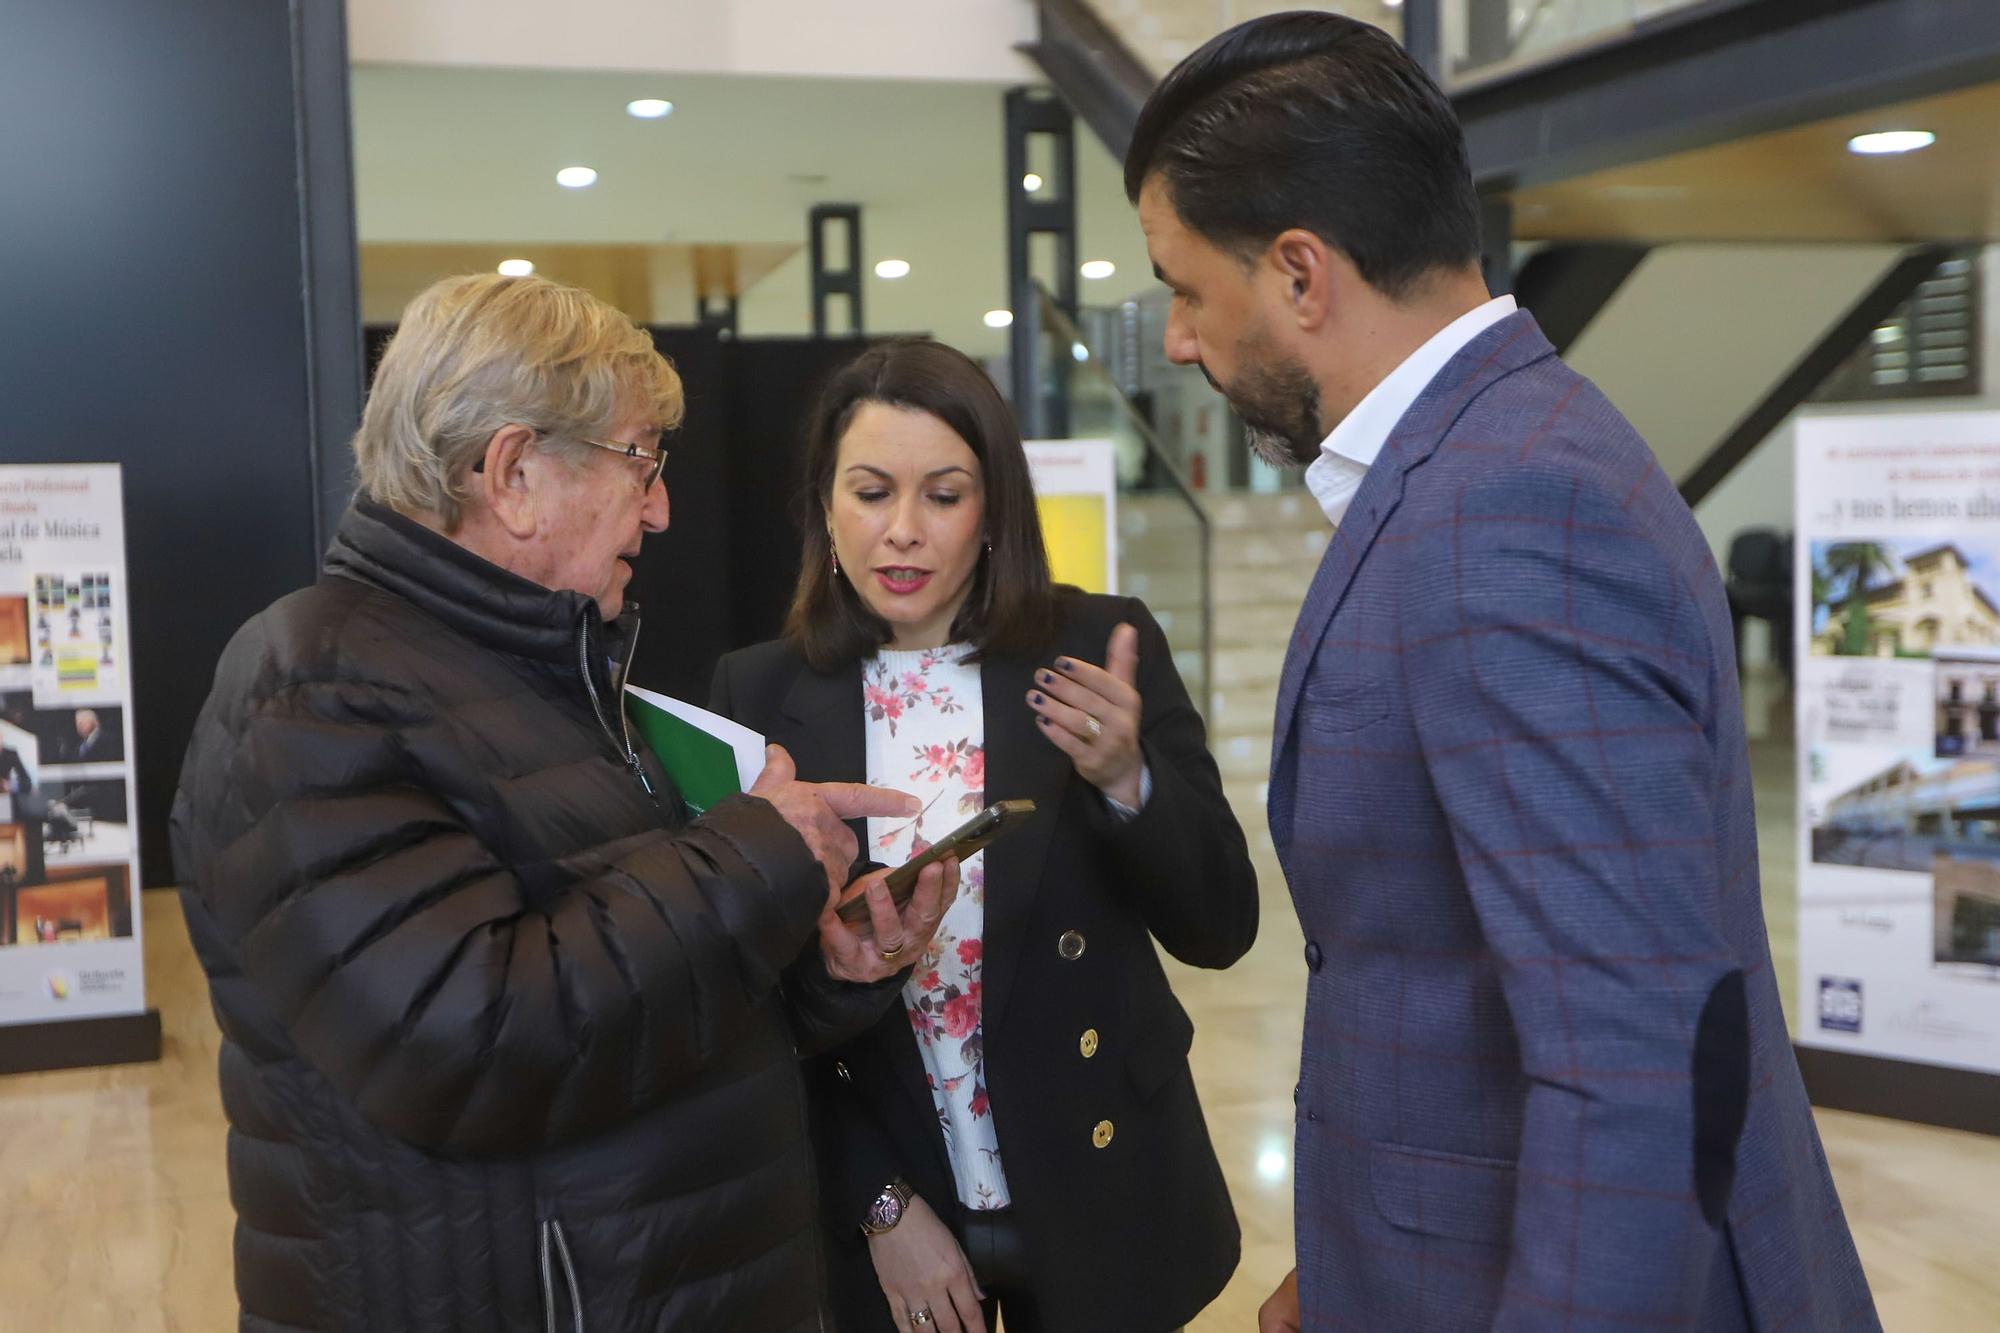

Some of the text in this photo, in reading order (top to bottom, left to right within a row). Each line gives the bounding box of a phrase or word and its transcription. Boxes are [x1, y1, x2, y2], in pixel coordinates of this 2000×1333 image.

[1851, 499, 1886, 519] nos
[1890, 490, 1959, 520] hemos
[21, 519, 40, 538] de
[44, 518, 100, 538] Música
